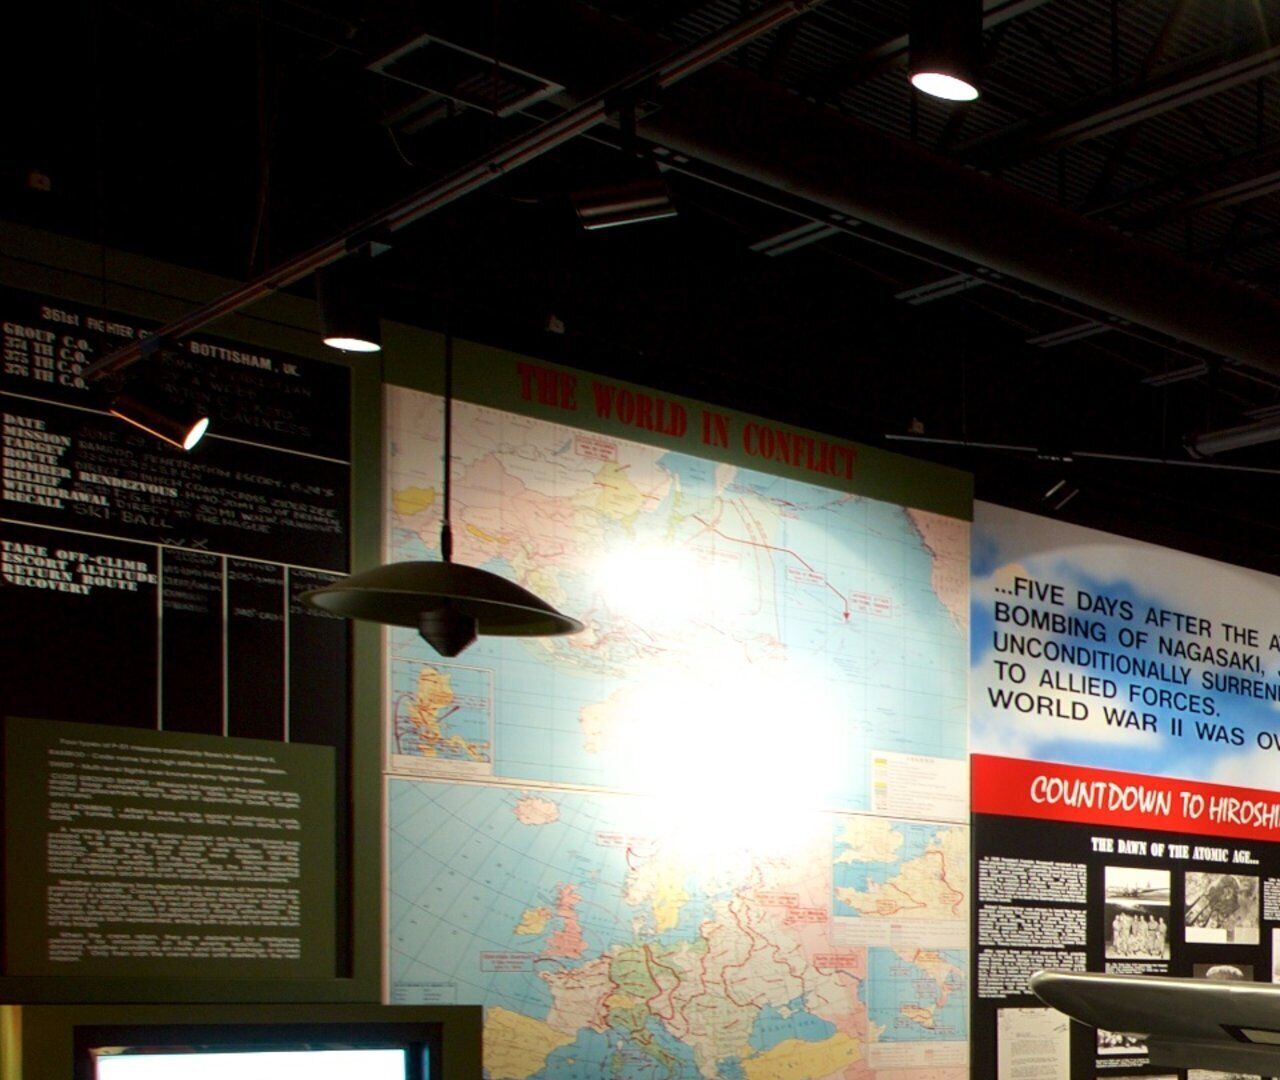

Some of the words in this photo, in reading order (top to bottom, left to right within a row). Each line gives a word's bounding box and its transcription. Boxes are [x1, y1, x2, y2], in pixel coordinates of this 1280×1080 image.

[2, 321, 56, 342] GROUP
[62, 336, 94, 353] C.O.
[2, 413, 46, 431] DATE
[2, 426, 72, 447] MISSION
[516, 361, 578, 411] THE
[591, 381, 688, 438] WORLD
[702, 409, 731, 449] IN
[742, 421, 857, 480] CONFLICT
[2, 436, 66, 456] TARGET
[2, 447, 59, 466] ROUTE
[2, 468, 63, 487] RELIEF
[2, 457, 72, 479] BOMBER
[78, 471, 179, 499] RENDEZVOUS
[2, 479, 110, 507] WITHDRAWAL
[2, 490, 65, 510] RECALL
[1, 540, 48, 557] TAKE
[55, 549, 148, 572] OFF-CLIMB
[1, 552, 69, 571] ESCORT
[76, 563, 157, 585] ALTITUDE
[1, 562, 73, 582] RETURN
[81, 574, 138, 592] ROUTE
[1077, 591, 1134, 622] DAYS
[1145, 606, 1213, 639] AFTER
[1221, 622, 1260, 648] THE
[994, 601, 1107, 643] BOMBING
[1118, 627, 1149, 651] OF
[1158, 635, 1265, 677] NAGASAKI,
[992, 631, 1192, 687] UNCONDITIONALLY
[994, 660, 1027, 685] TO
[1039, 668, 1117, 699] ALLIED
[1129, 685, 1221, 718] FORCES.
[987, 687, 1090, 722] WORLD
[1103, 707, 1158, 734] WAR
[1171, 716, 1183, 737] II
[1197, 723, 1246, 746] WAS
[1030, 775, 1171, 814] COUNTDOWN
[1180, 794, 1205, 818] TO
[1091, 837, 1114, 852] THE
[1118, 839, 1147, 856] DAWN
[1150, 843, 1165, 857] OF
[1168, 844, 1189, 859] THE
[1193, 846, 1228, 862] ATOMIC
